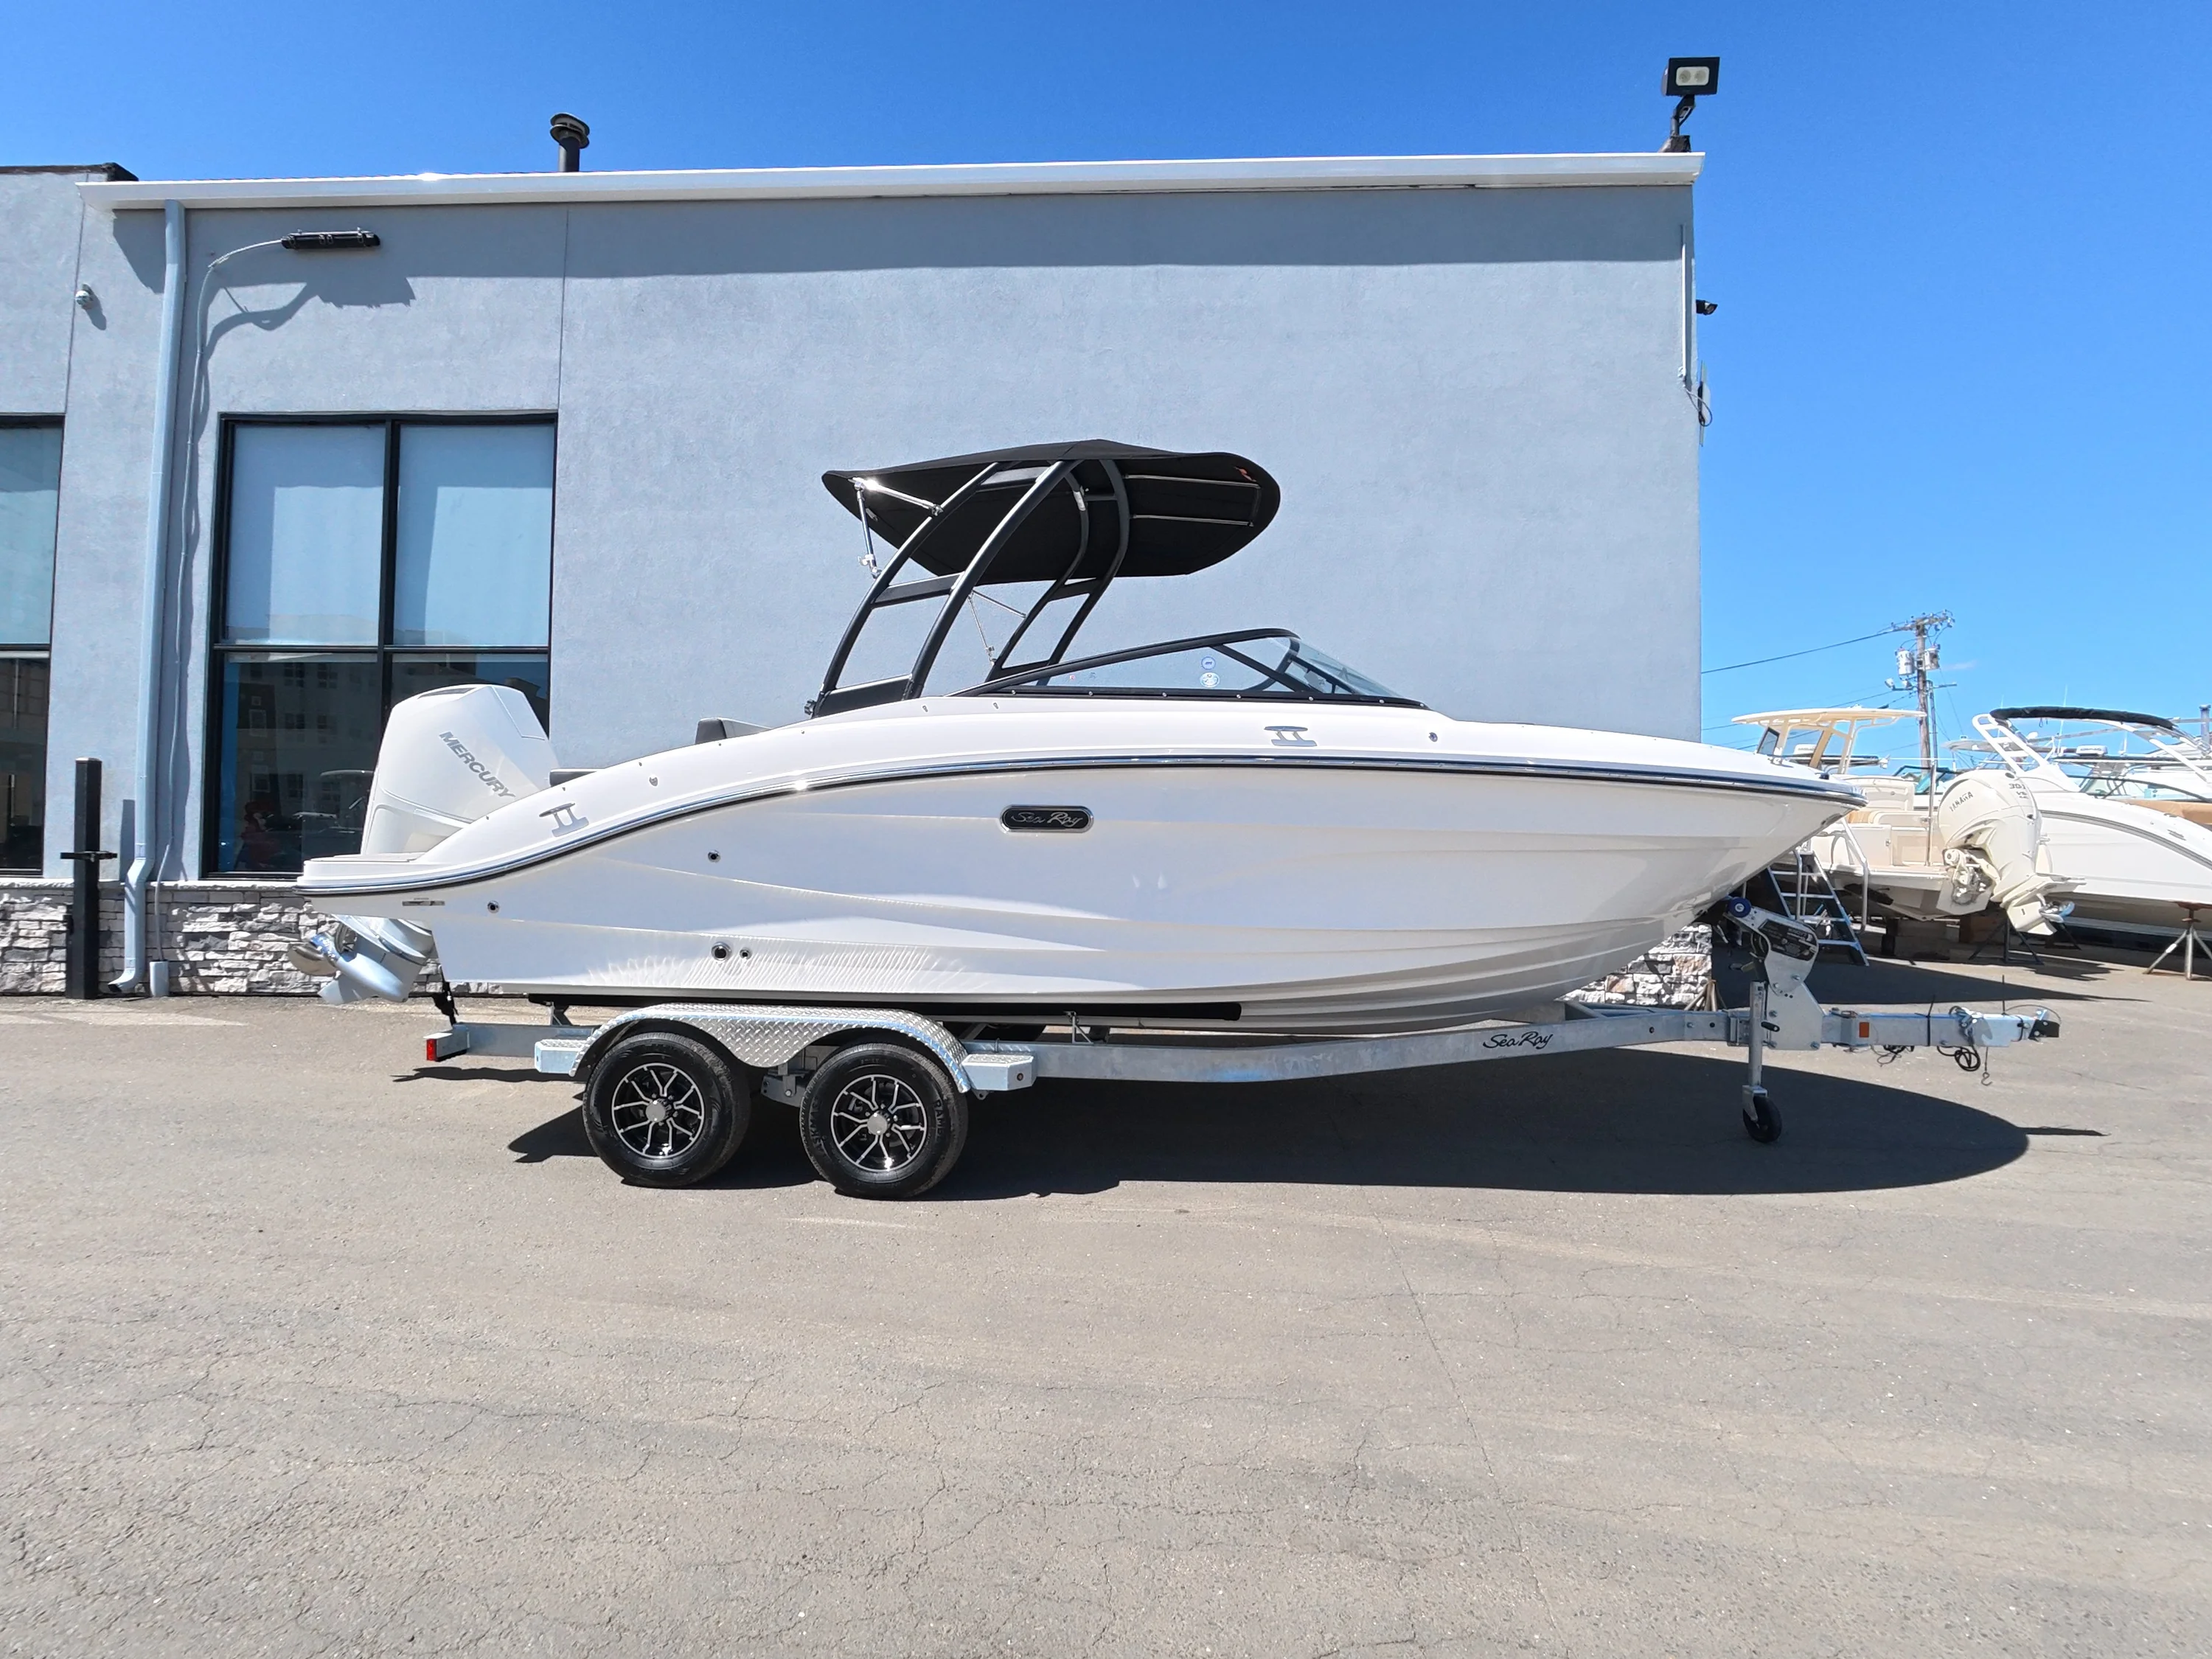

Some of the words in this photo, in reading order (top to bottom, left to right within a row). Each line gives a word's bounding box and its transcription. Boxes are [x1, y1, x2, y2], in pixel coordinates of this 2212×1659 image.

[439, 731, 516, 798] MERCURY
[1011, 812, 1046, 824] Sea
[1047, 812, 1083, 827] Ray
[1483, 1034, 1520, 1048] Sea
[1518, 1031, 1554, 1049] Ray
